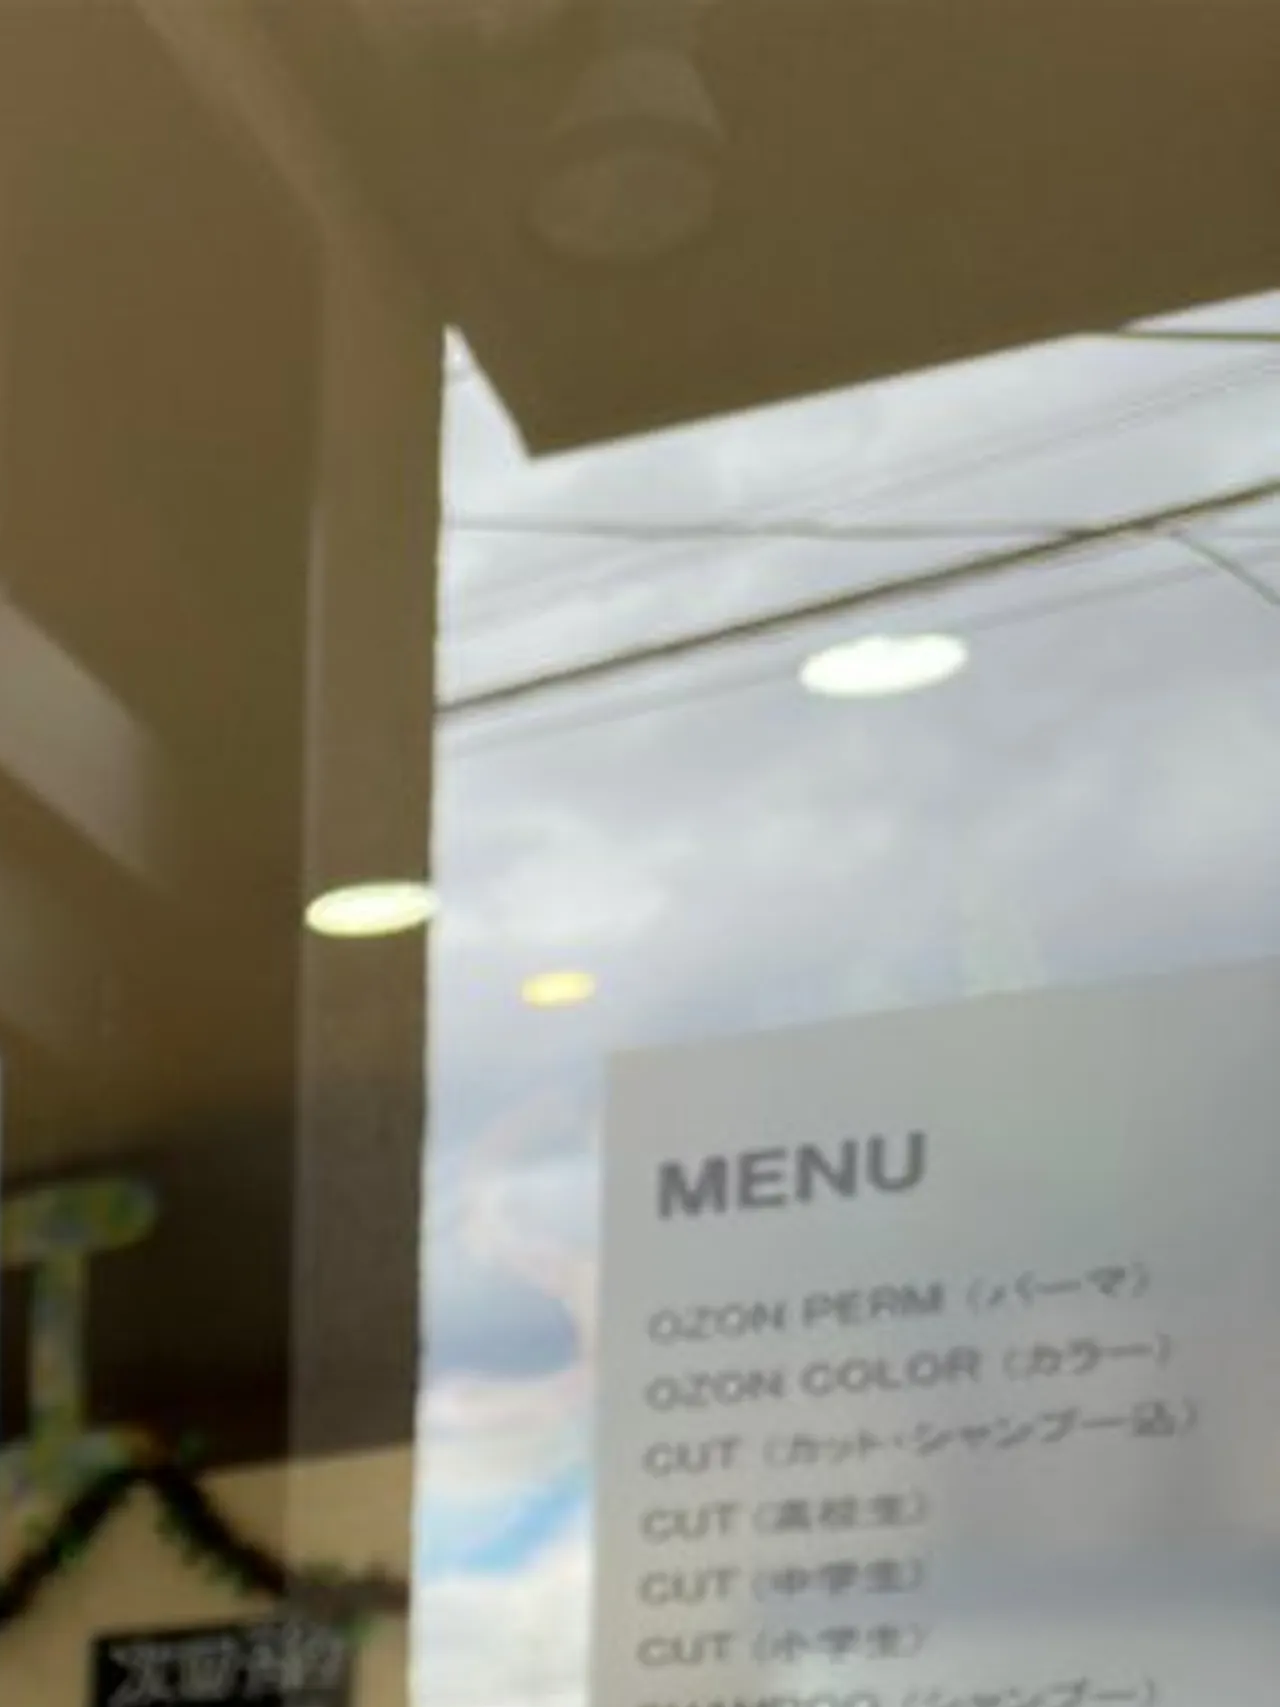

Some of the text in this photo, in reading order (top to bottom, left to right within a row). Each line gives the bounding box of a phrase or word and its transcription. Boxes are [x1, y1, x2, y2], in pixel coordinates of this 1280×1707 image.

[656, 1131, 927, 1220] MENU
[646, 1303, 786, 1346] OZON
[801, 1282, 946, 1330] PERM
[644, 1367, 785, 1412] OZON
[799, 1345, 982, 1398] COLOR
[644, 1437, 741, 1478] CUT
[640, 1504, 738, 1543] CUT
[639, 1569, 737, 1608] CUT
[636, 1632, 734, 1669] CUT
